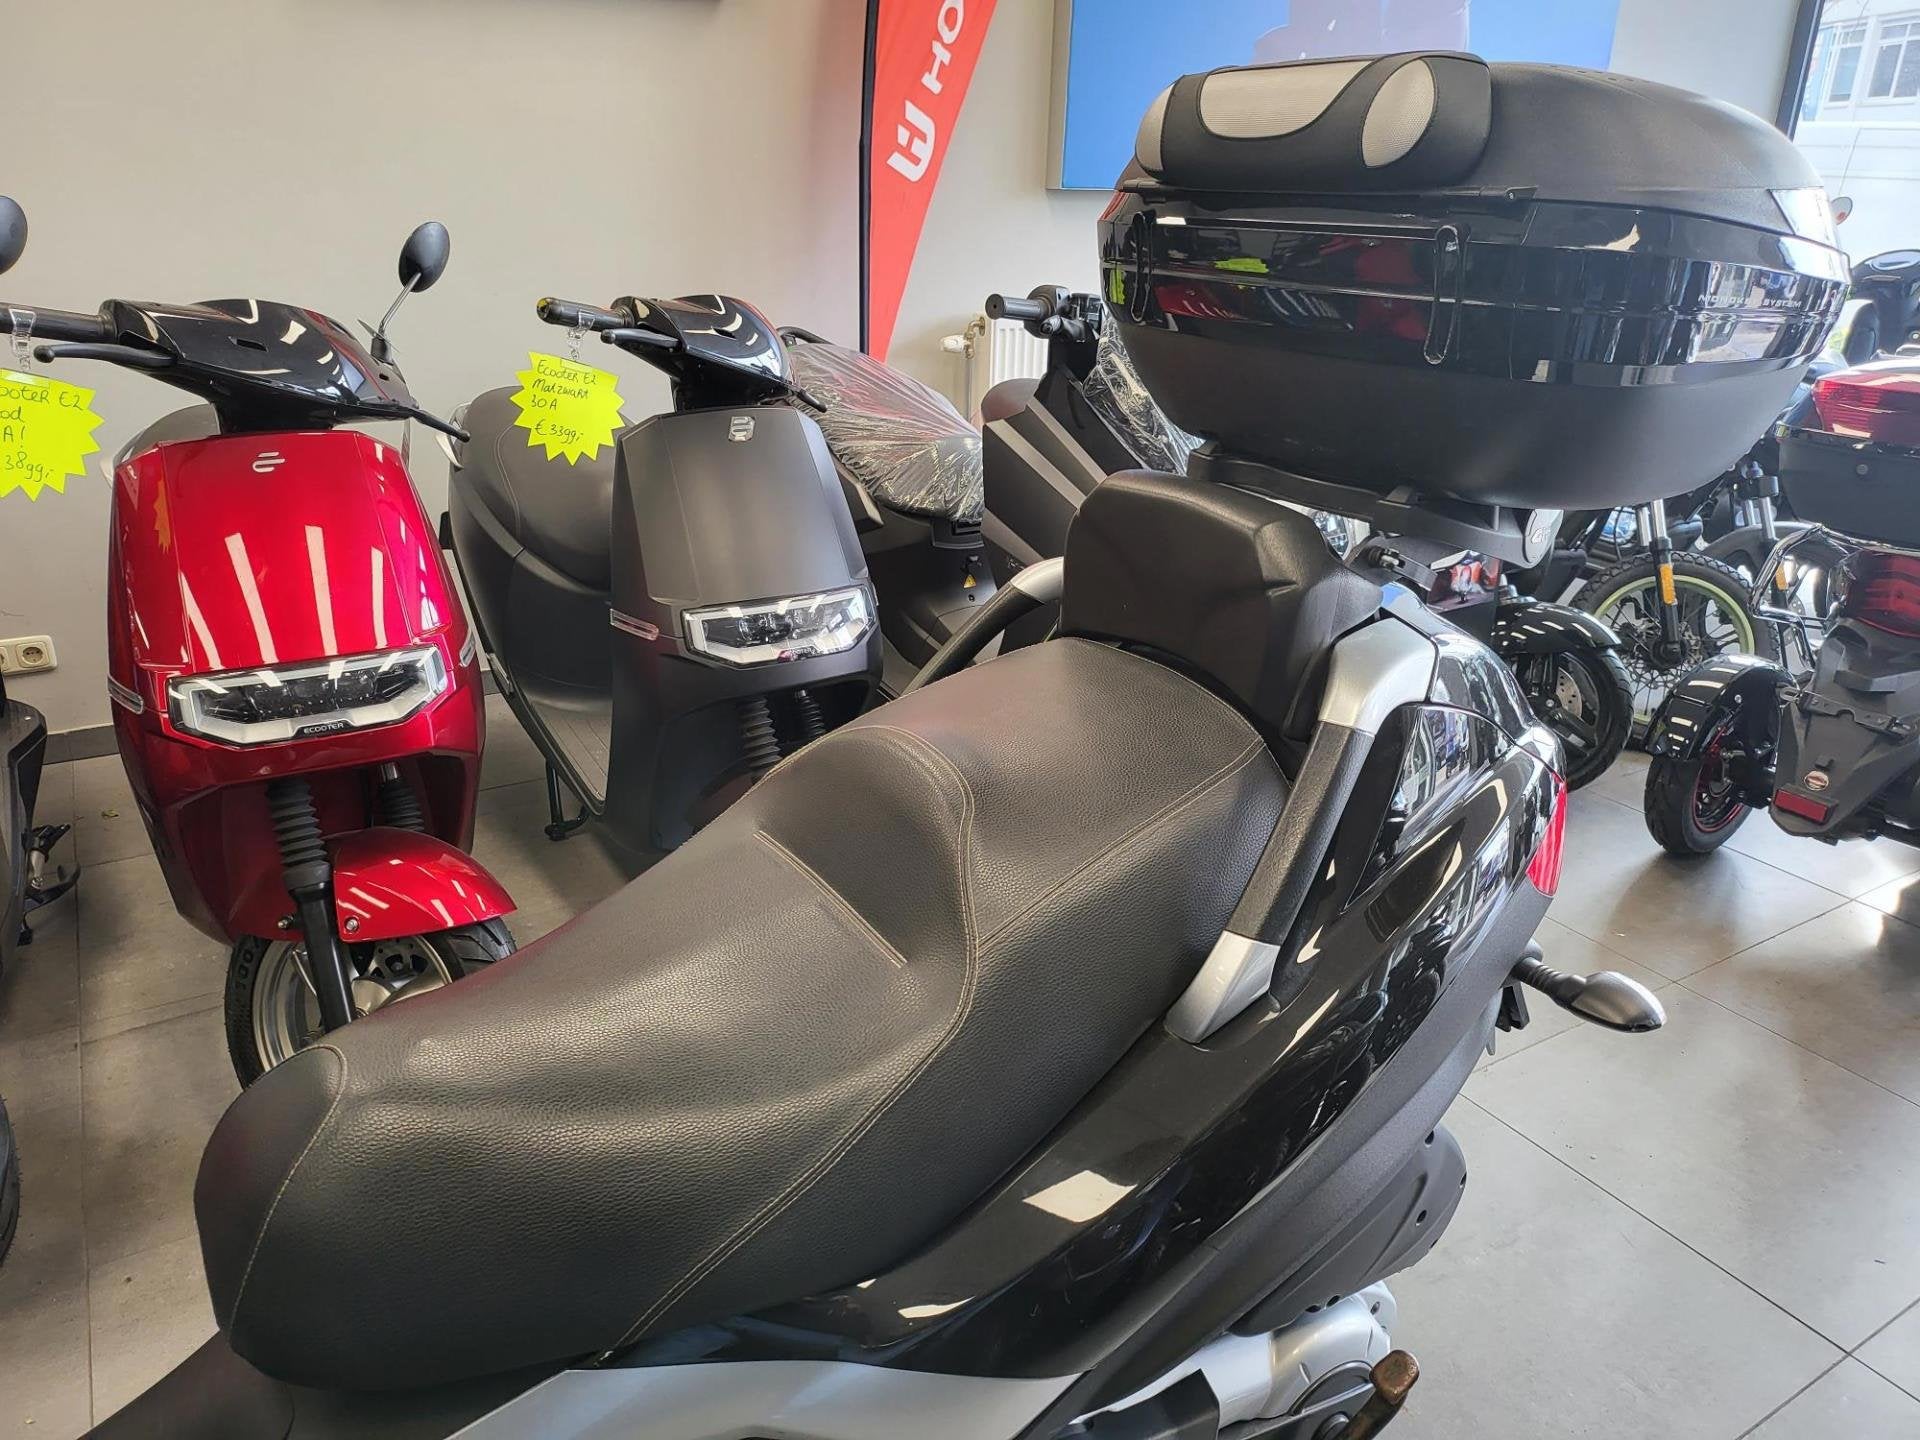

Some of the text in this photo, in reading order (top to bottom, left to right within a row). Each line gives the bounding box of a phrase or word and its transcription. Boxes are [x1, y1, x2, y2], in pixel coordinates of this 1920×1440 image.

[531, 394, 557, 411] 30 A
[303, 722, 344, 734] ECOOTER
